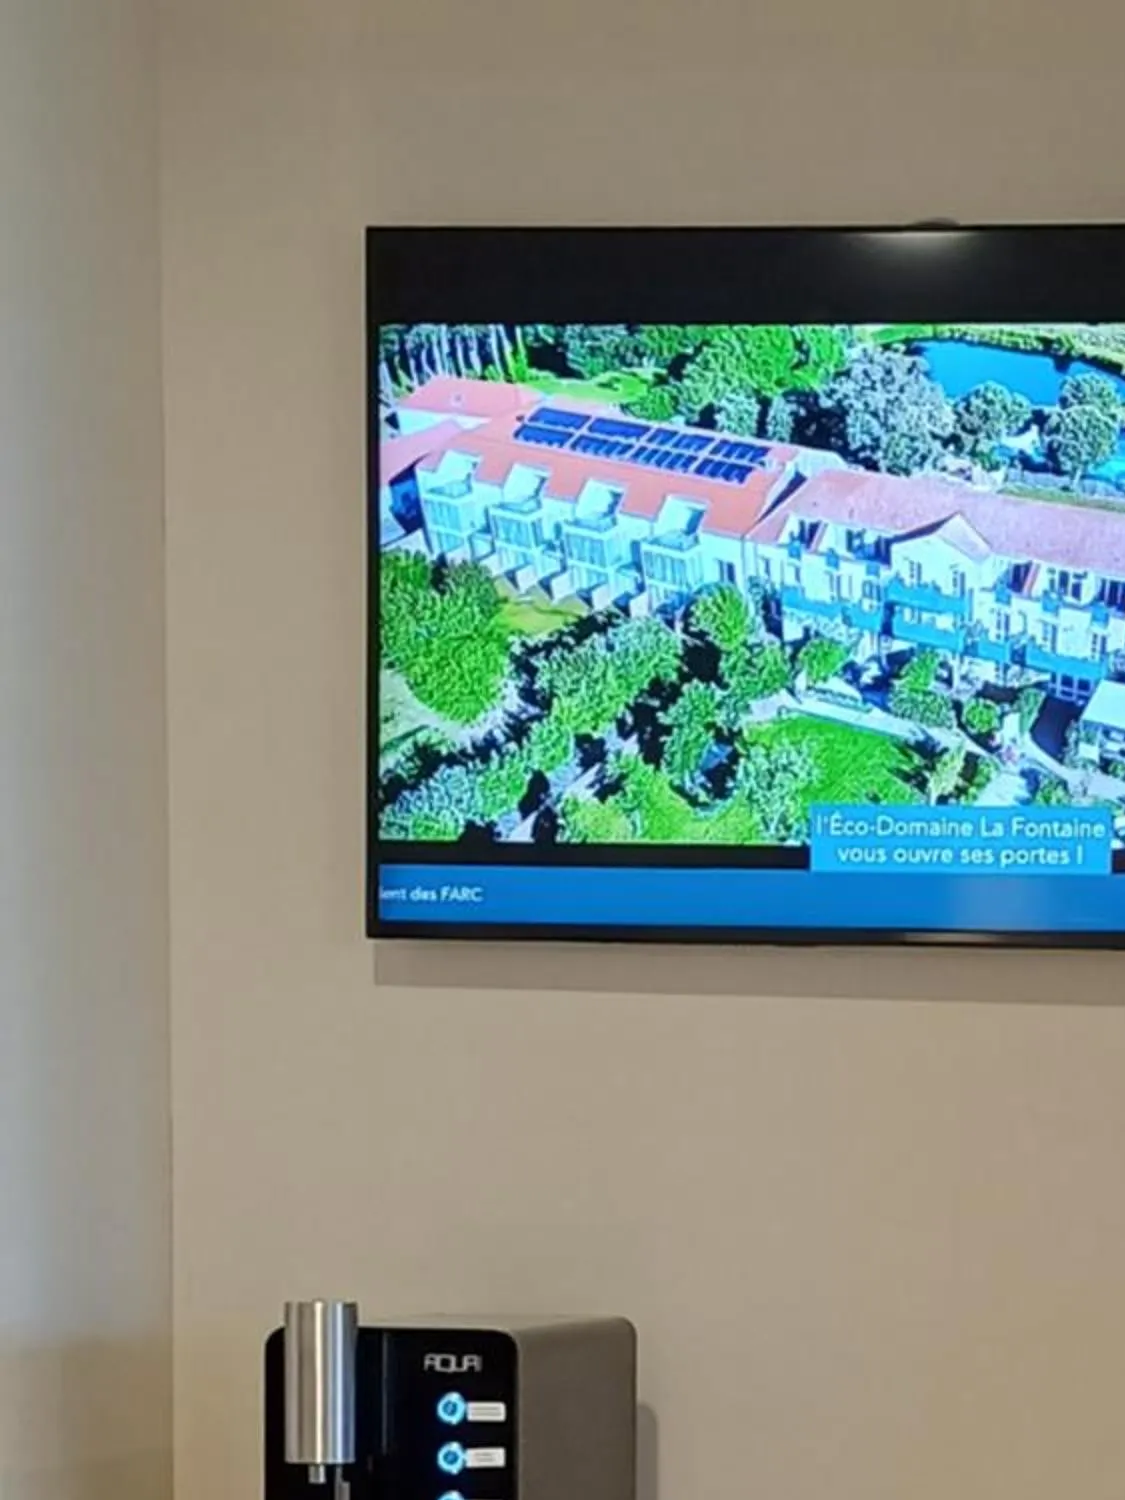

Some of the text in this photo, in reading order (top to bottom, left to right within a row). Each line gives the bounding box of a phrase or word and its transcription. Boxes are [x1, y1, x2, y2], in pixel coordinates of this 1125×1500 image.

[815, 811, 1106, 839] l'Éco-Domaine La Fontaine
[837, 846, 887, 864] vous
[893, 846, 953, 864] ouvre
[960, 848, 994, 865] ses
[1000, 847, 1070, 868] portes
[410, 884, 437, 901] des
[440, 885, 484, 901] FARC
